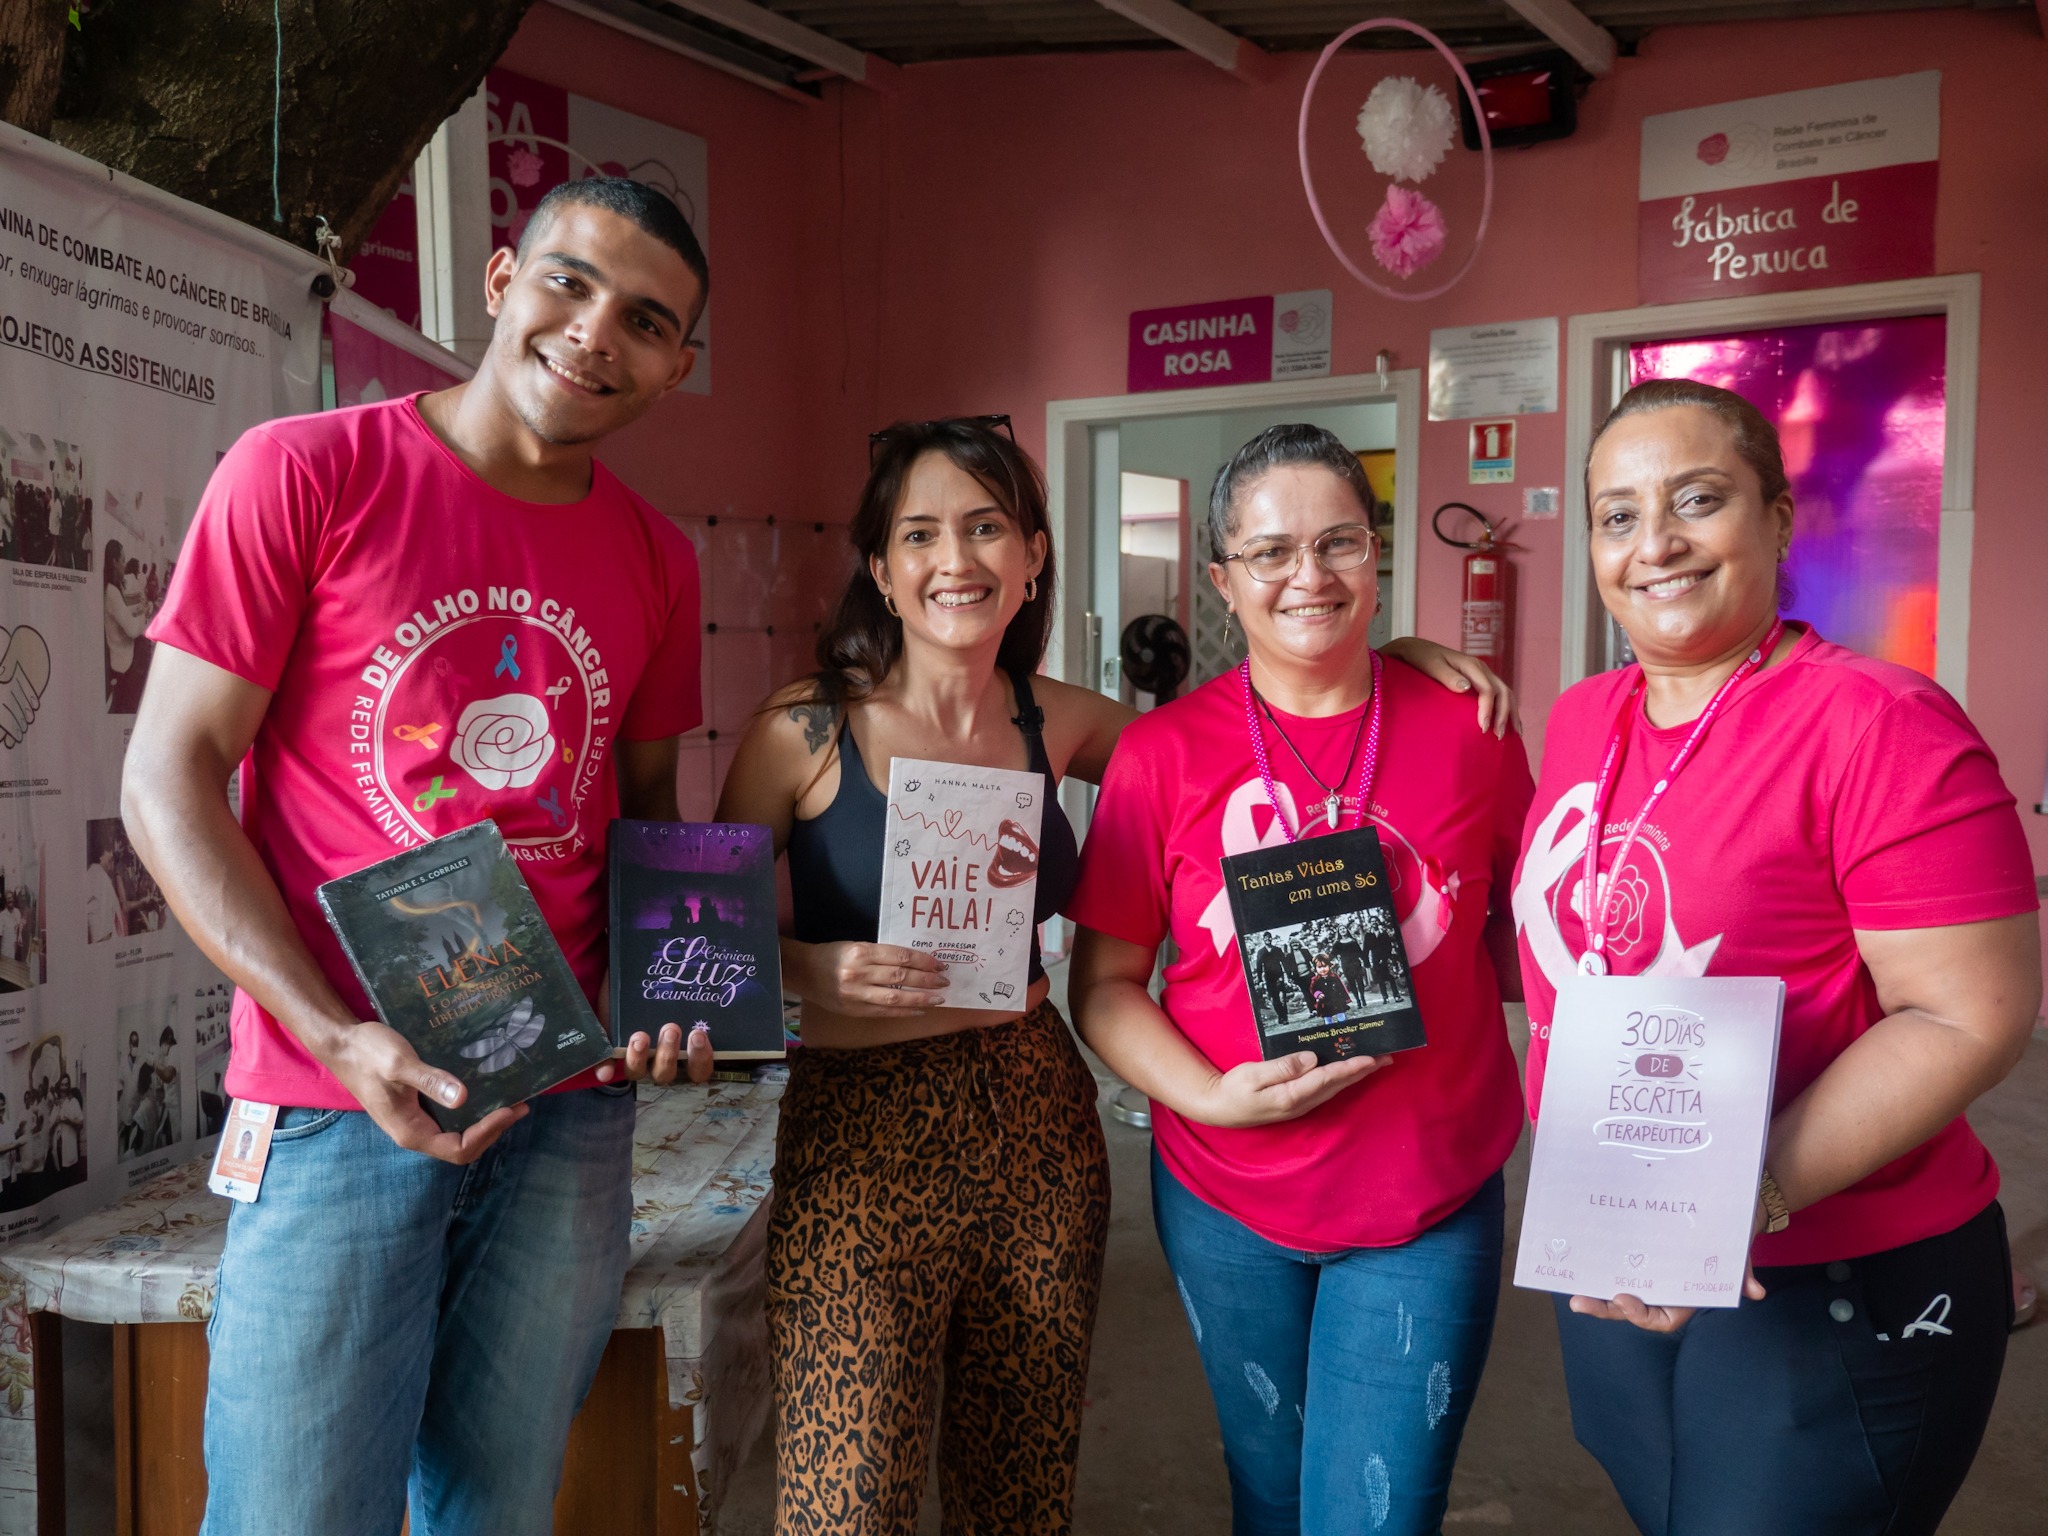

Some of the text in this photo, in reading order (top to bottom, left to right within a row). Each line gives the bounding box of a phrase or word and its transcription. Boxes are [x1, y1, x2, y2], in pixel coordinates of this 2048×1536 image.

[1672, 180, 1859, 248] Fábrica de
[39, 223, 59, 252] DE
[63, 235, 142, 281] COMBATE
[145, 265, 166, 290] AO
[170, 274, 227, 313] CÂNCER
[231, 296, 249, 319] DE
[1707, 241, 1829, 282] Peruca
[20, 259, 74, 297] enxugar
[76, 280, 138, 317] lágrimas
[142, 305, 150, 321] e
[153, 308, 207, 340] provocar
[210, 328, 265, 359] sorrisos...
[1142, 313, 1257, 347] CASINHA
[79, 342, 216, 402] ASSISTENCIAIS
[1164, 348, 1233, 377] ROSA
[361, 644, 401, 690] DE
[394, 588, 480, 648] OLHO
[488, 586, 532, 613] NO
[540, 598, 611, 711] CÂNCER
[351, 695, 375, 755] REDE
[934, 778, 1002, 792] HANNA MALTA
[706, 828, 750, 838] ZAGO
[375, 858, 469, 902] TATIANA E. S. CORRALES
[966, 864, 980, 893] E
[1238, 857, 1345, 892] Tantas Vidas
[1288, 871, 1377, 904] em uma Só
[911, 896, 993, 932] FALA!
[417, 938, 522, 998] ELENA
[704, 944, 756, 962] Crônicas
[441, 998, 451, 1009] O
[511, 963, 530, 977] DA
[484, 971, 543, 1002] PRATEADA
[647, 936, 758, 1008] da Luz e
[641, 979, 721, 1003] Escuridão
[1298, 1031, 1330, 1043] Jaqueline
[1359, 1020, 1385, 1030] Zimmer
[1621, 1010, 1663, 1047] 30
[1650, 1057, 1670, 1073] DE
[1608, 1084, 1703, 1114] ESCRITA
[1604, 1122, 1702, 1145] TERAPÊUTICA
[1590, 1194, 1697, 1214] LELLA MALTA
[1534, 1264, 1735, 1293] ACOLHER REVELAR EMPODERAR
